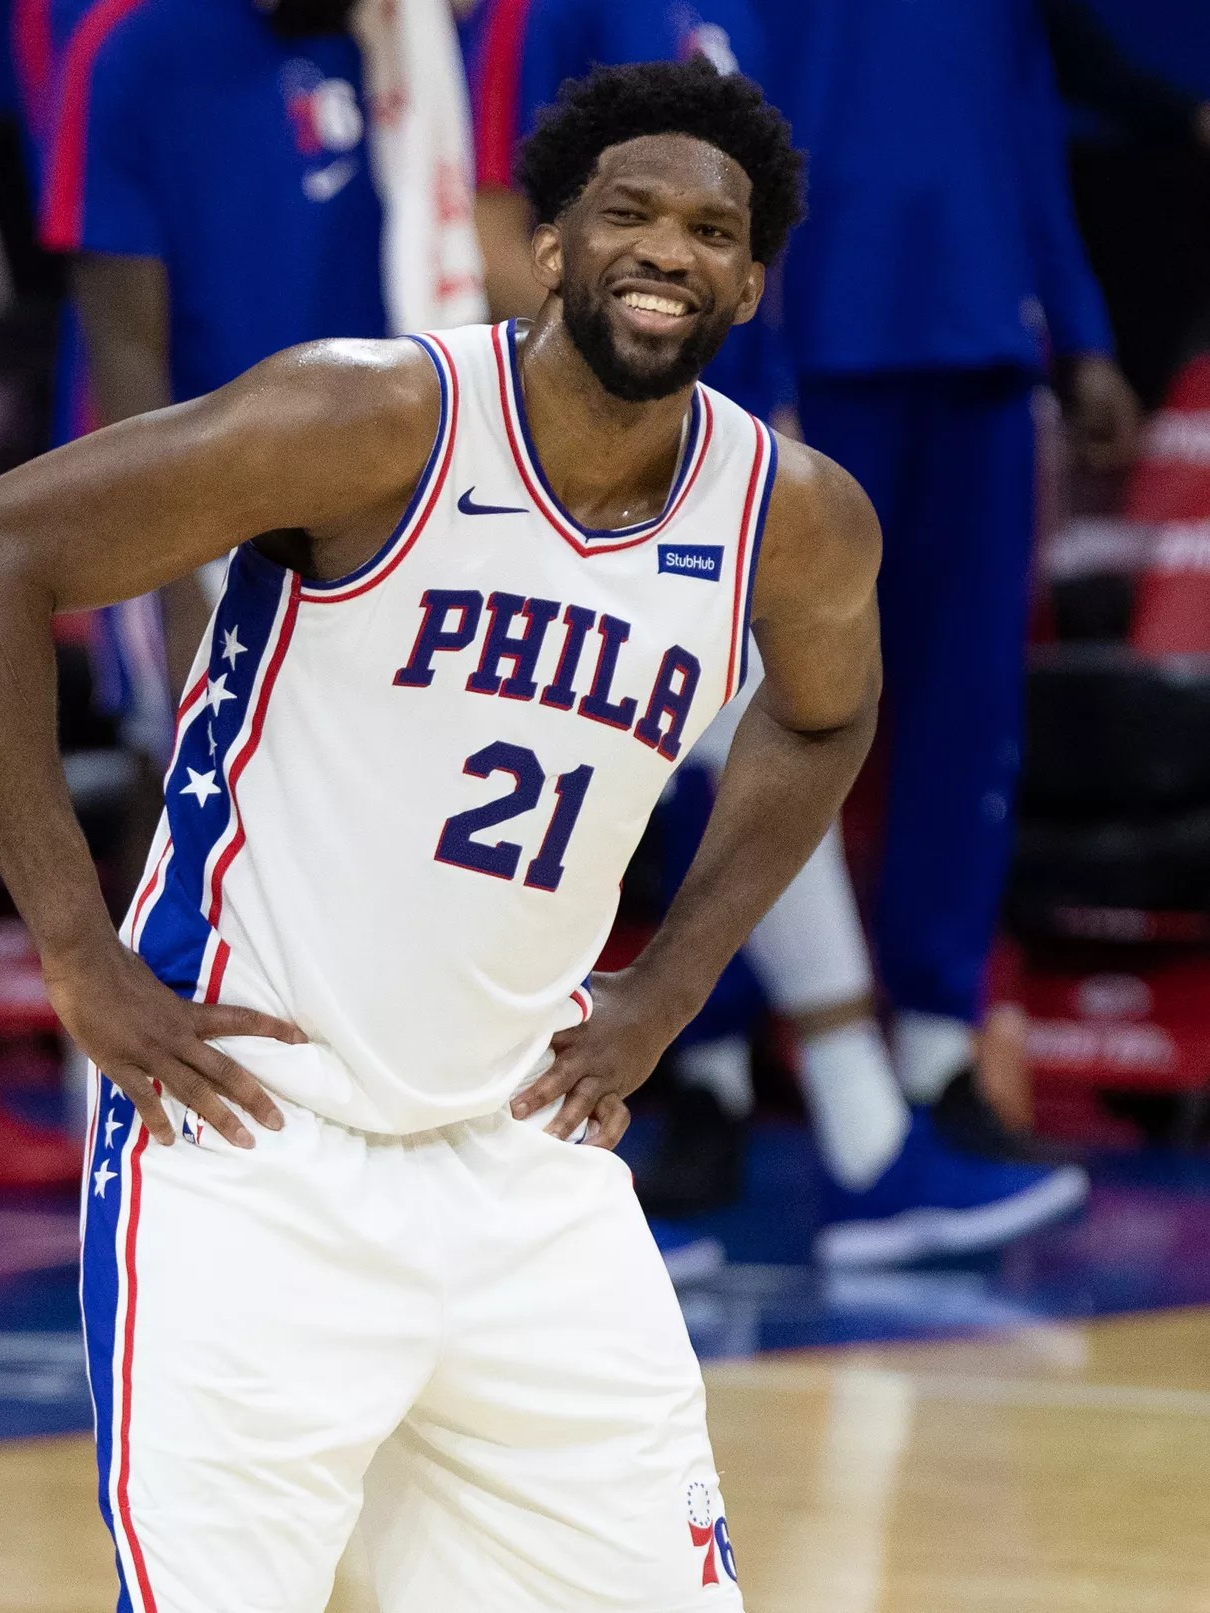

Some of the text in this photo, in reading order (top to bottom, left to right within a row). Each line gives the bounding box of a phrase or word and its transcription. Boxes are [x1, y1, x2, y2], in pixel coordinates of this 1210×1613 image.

[666, 552, 715, 570] StubHub
[392, 589, 701, 762] PHILA
[434, 740, 595, 892] 21
[688, 1517, 738, 1587] 76
